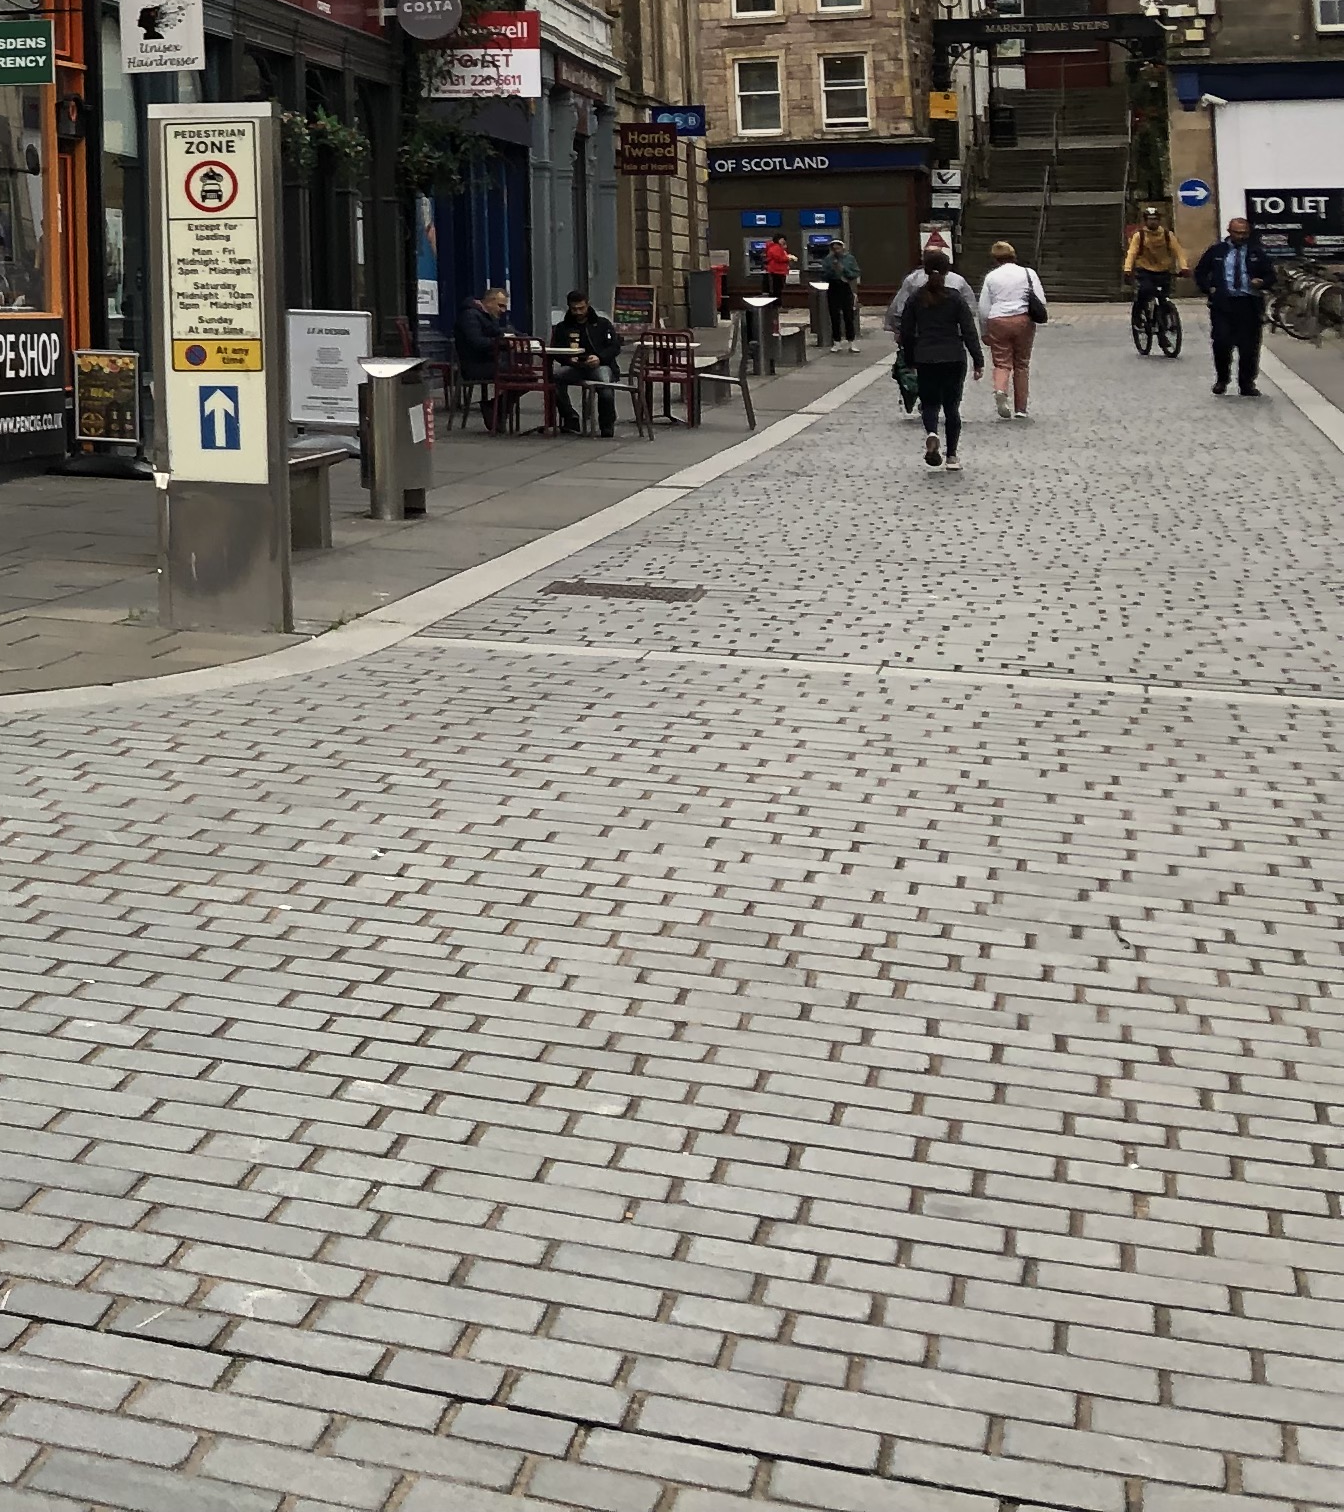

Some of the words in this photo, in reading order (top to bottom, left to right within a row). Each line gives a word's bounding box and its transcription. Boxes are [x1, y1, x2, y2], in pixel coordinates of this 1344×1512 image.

[403, 0, 453, 14] COSTA
[985, 23, 1034, 33] MARKET
[1036, 22, 1069, 32] BRAE
[1072, 20, 1110, 31] STEPS
[138, 42, 182, 54] Unisex
[127, 54, 199, 68] Hairdresser
[480, 53, 514, 69] LET
[174, 129, 246, 139] PEDESTRIAN
[628, 131, 671, 144] Harris
[185, 140, 237, 155] ZONE
[623, 145, 675, 158] Tweed
[715, 159, 737, 172] OF
[742, 155, 829, 172] SCOTLAND
[1251, 196, 1285, 214] TO
[1291, 196, 1330, 216] LET
[187, 223, 221, 232] Except
[224, 222, 238, 231] for
[192, 247, 213, 255] Mon
[222, 247, 236, 255] Fri
[176, 257, 219, 267] Midnight
[208, 267, 252, 276] Midnight
[193, 281, 237, 291] Saturday
[176, 291, 219, 301] Midnight
[228, 291, 254, 299] 10am
[209, 301, 253, 310] Midnight
[197, 316, 234, 325] Sunday
[188, 326, 200, 334] At
[202, 327, 219, 336] any
[223, 326, 245, 335] time
[18, 332, 61, 379] SHOP
[216, 346, 228, 355] At
[231, 347, 250, 357] any
[222, 357, 245, 365] time
